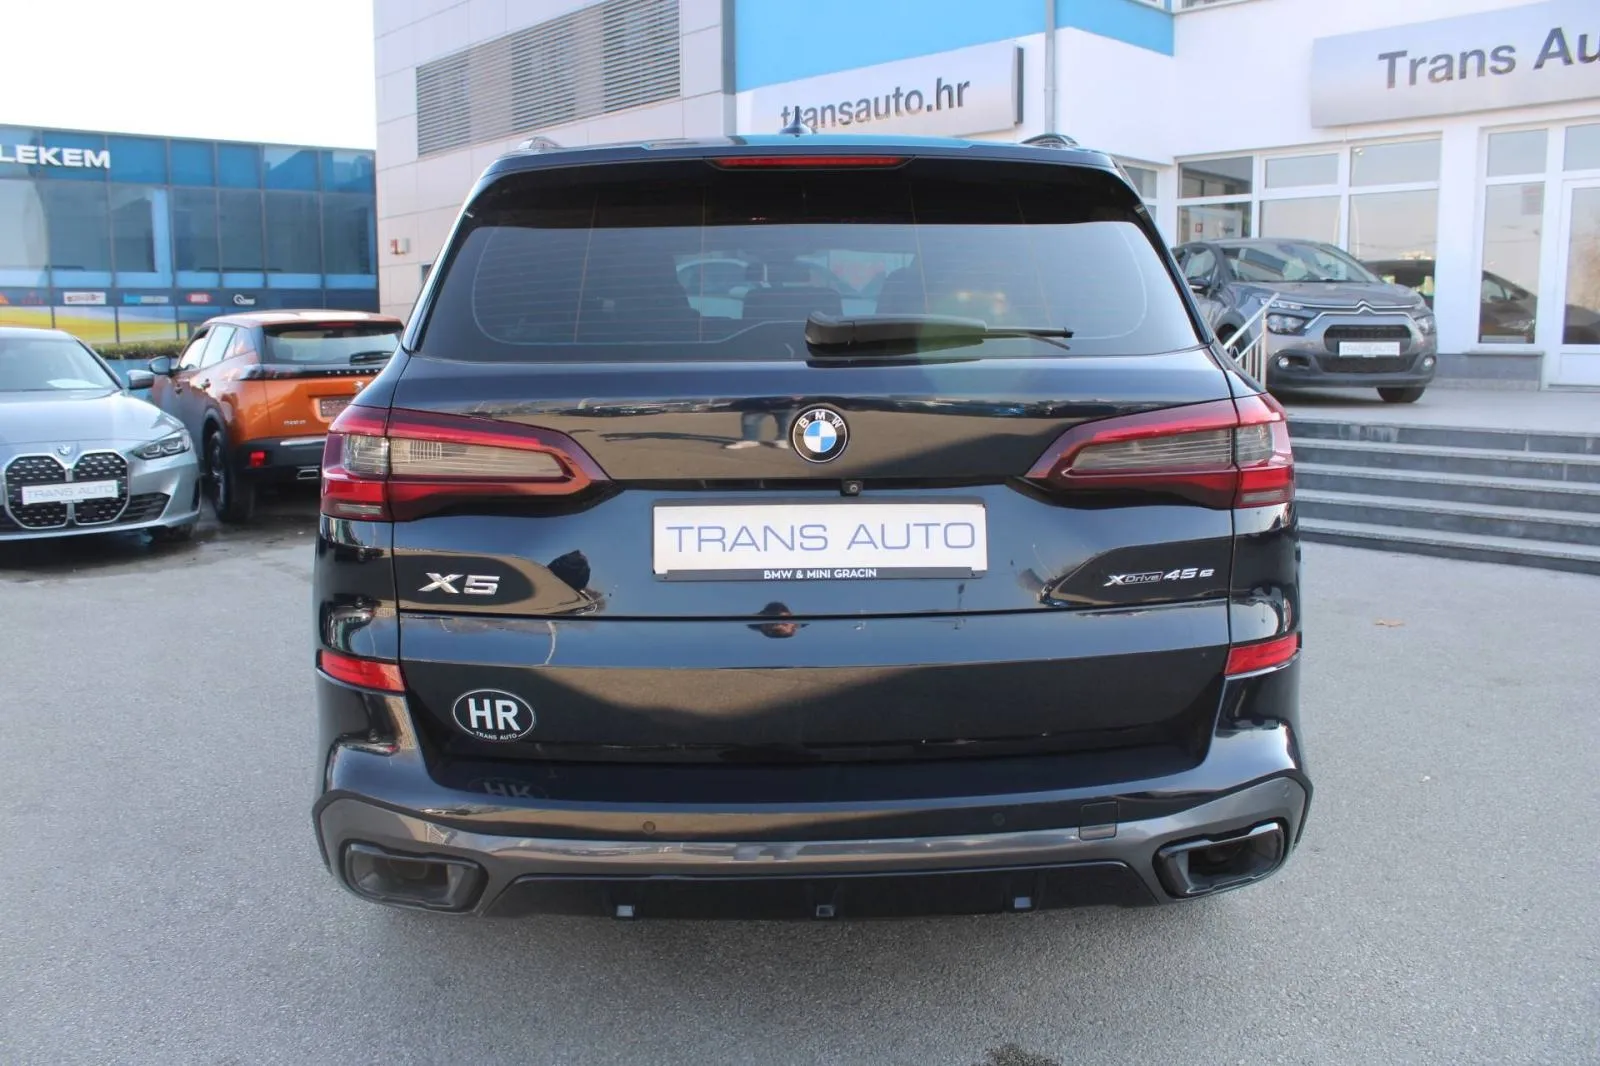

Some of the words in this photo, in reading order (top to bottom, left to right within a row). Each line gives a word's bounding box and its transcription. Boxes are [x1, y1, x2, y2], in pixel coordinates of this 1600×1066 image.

[1377, 44, 1517, 89] Trans
[780, 76, 971, 129] tansauto.hr
[798, 410, 843, 429] BMW
[27, 487, 73, 500] TRANS
[77, 484, 115, 495] AUTO
[665, 524, 829, 553] TRANS
[846, 522, 976, 551] AUTO
[417, 572, 501, 596] X5
[763, 569, 793, 580] BMW
[795, 569, 804, 580] &
[806, 569, 831, 579] MINI
[834, 568, 877, 579] GRACIN
[467, 697, 522, 731] HR
[475, 730, 498, 741] TRANS
[499, 732, 518, 741] AUTO
